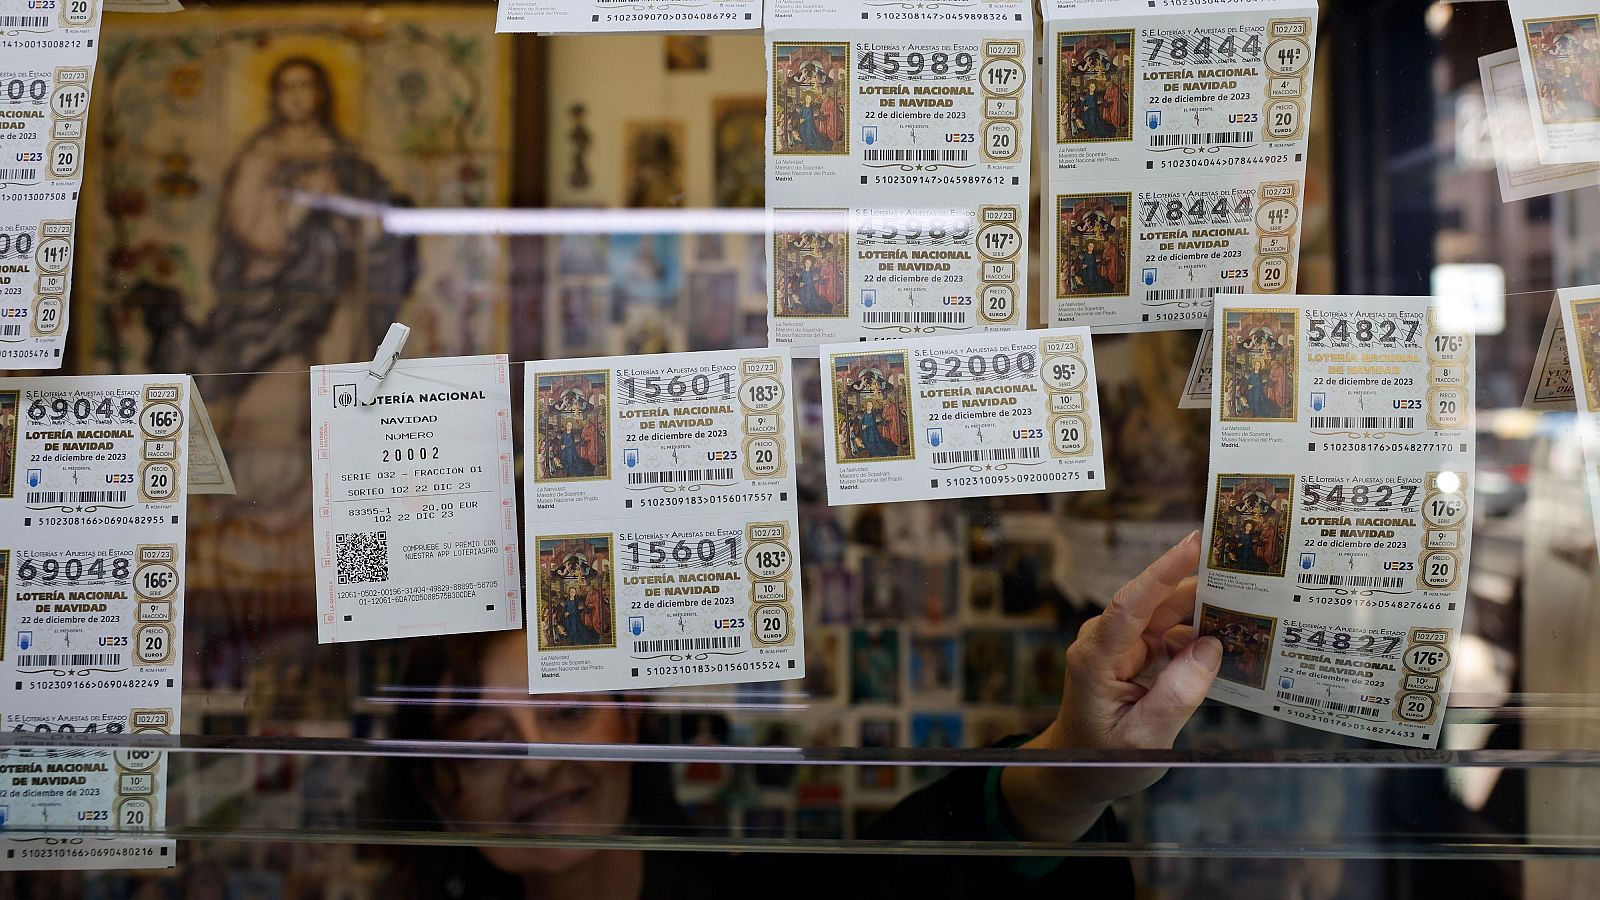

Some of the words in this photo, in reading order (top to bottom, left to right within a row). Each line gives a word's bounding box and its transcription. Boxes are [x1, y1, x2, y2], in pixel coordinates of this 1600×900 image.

[71, 1, 87, 12] 20
[607, 13, 737, 21] 5102309070>0304086792
[876, 12, 1008, 21] 5102308147>0459898326
[1147, 35, 1262, 61] 78444
[858, 52, 973, 76] 45989
[988, 68, 1017, 85] 147ª
[1143, 69, 1195, 81] LOTERÍA
[1198, 67, 1258, 78] NACIONAL
[859, 85, 910, 95] LOTERÍA
[914, 86, 974, 95] NACIONAL
[1163, 83, 1179, 92] DE
[1183, 81, 1237, 91] NAVIDAD
[880, 99, 895, 107] DE
[899, 98, 953, 107] NAVIDAD
[878, 111, 888, 119] de
[890, 111, 931, 119] diciembre
[933, 111, 943, 119] de
[1275, 113, 1292, 126] 20
[992, 135, 1009, 147] 20
[58, 153, 72, 164] 20
[1161, 154, 1288, 168] 5102304044>0784449025
[875, 176, 1005, 185] 5102309147>0459897612
[1144, 197, 1252, 222] 78444
[985, 233, 1013, 249] 147ª
[858, 250, 909, 260] LOTERÍA
[911, 250, 971, 260] NACIONAL
[879, 263, 894, 271] DE
[898, 263, 951, 271] NAVIDAD
[1264, 269, 1280, 281] 20
[990, 298, 1006, 310] 20
[1308, 320, 1420, 343] 54827
[919, 352, 1035, 379] 92000
[625, 373, 732, 399] 15601
[920, 386, 973, 398] LOTERÍA
[976, 384, 1037, 395] NACIONAL
[362, 392, 414, 406] TERÍA
[419, 390, 486, 402] NACIONAL
[749, 386, 778, 402] 183ª
[27, 398, 136, 420] 69048
[942, 400, 959, 409] DE
[962, 397, 1017, 408] NAVIDAD
[1440, 401, 1456, 414] 20
[619, 407, 671, 419] LOTERÍA
[673, 405, 733, 416] NACIONAL
[955, 411, 996, 420] diciembre
[1012, 408, 1032, 417] 2023
[150, 411, 178, 427] 166ª
[381, 415, 438, 425] NAVIDAD
[640, 420, 656, 430] DE
[659, 418, 714, 428] NAVIDAD
[26, 429, 71, 440] LOTERÍA
[77, 430, 134, 438] NACIONAL
[626, 434, 636, 442] 22
[638, 433, 649, 441] de
[651, 432, 692, 441] diciembre
[708, 430, 727, 438] 2023
[1061, 428, 1078, 442] 20
[45, 443, 59, 451] DE
[62, 442, 114, 450] NAVIDAD
[1323, 443, 1453, 452] 5102308176>0548277170
[756, 449, 773, 463] 20
[151, 474, 167, 488] 20
[342, 472, 370, 482] SERIE
[946, 472, 1080, 487] 5102310095>0920000275
[348, 487, 384, 497] SORTEO
[391, 486, 409, 494] 102
[416, 484, 428, 492] 22
[434, 483, 452, 492] DIC
[459, 482, 471, 490] 23
[1303, 484, 1418, 507] 54827
[640, 494, 773, 507] 5102309183>0156017557
[348, 507, 390, 516] 83355-1
[374, 515, 392, 523] 102
[417, 512, 435, 520] DIC
[38, 516, 164, 526] 5102308166>0690482955
[1301, 515, 1352, 526] LOTERÍA
[1355, 516, 1416, 527] NACIONAL
[1320, 528, 1335, 538] DE
[1339, 529, 1395, 538] NAVIDAD
[403, 543, 440, 552] COMPRUEBE
[405, 552, 434, 560] NUESTRA
[438, 550, 450, 558] APP
[454, 547, 498, 556] LOTERIASPRO
[627, 537, 738, 564] 15601
[756, 551, 786, 569] 183ª
[18, 558, 129, 580] 69048
[1432, 563, 1448, 576] 20
[143, 572, 172, 589] 166ª
[16, 590, 65, 601] LOTERÍA
[69, 592, 128, 600] NACIONAL
[36, 604, 50, 613] DE
[54, 603, 107, 612] NAVIDAD
[1309, 596, 1441, 610] 5102309176>0548276466
[763, 618, 780, 632] 20
[145, 637, 162, 650] 20
[1285, 627, 1401, 654] 54827
[647, 661, 780, 675] 5102310183>0156015524
[30, 680, 160, 690] 5102309166>0690482249
[1408, 701, 1425, 712] 20
[1287, 709, 1415, 738] 5102310176>0548274433
[47, 762, 108, 772] NACIONAL
[12, 777, 28, 786] DE
[32, 776, 86, 785] NAVIDAD
[126, 811, 144, 824] 20
[22, 847, 153, 858] 5102310166>0690480216
